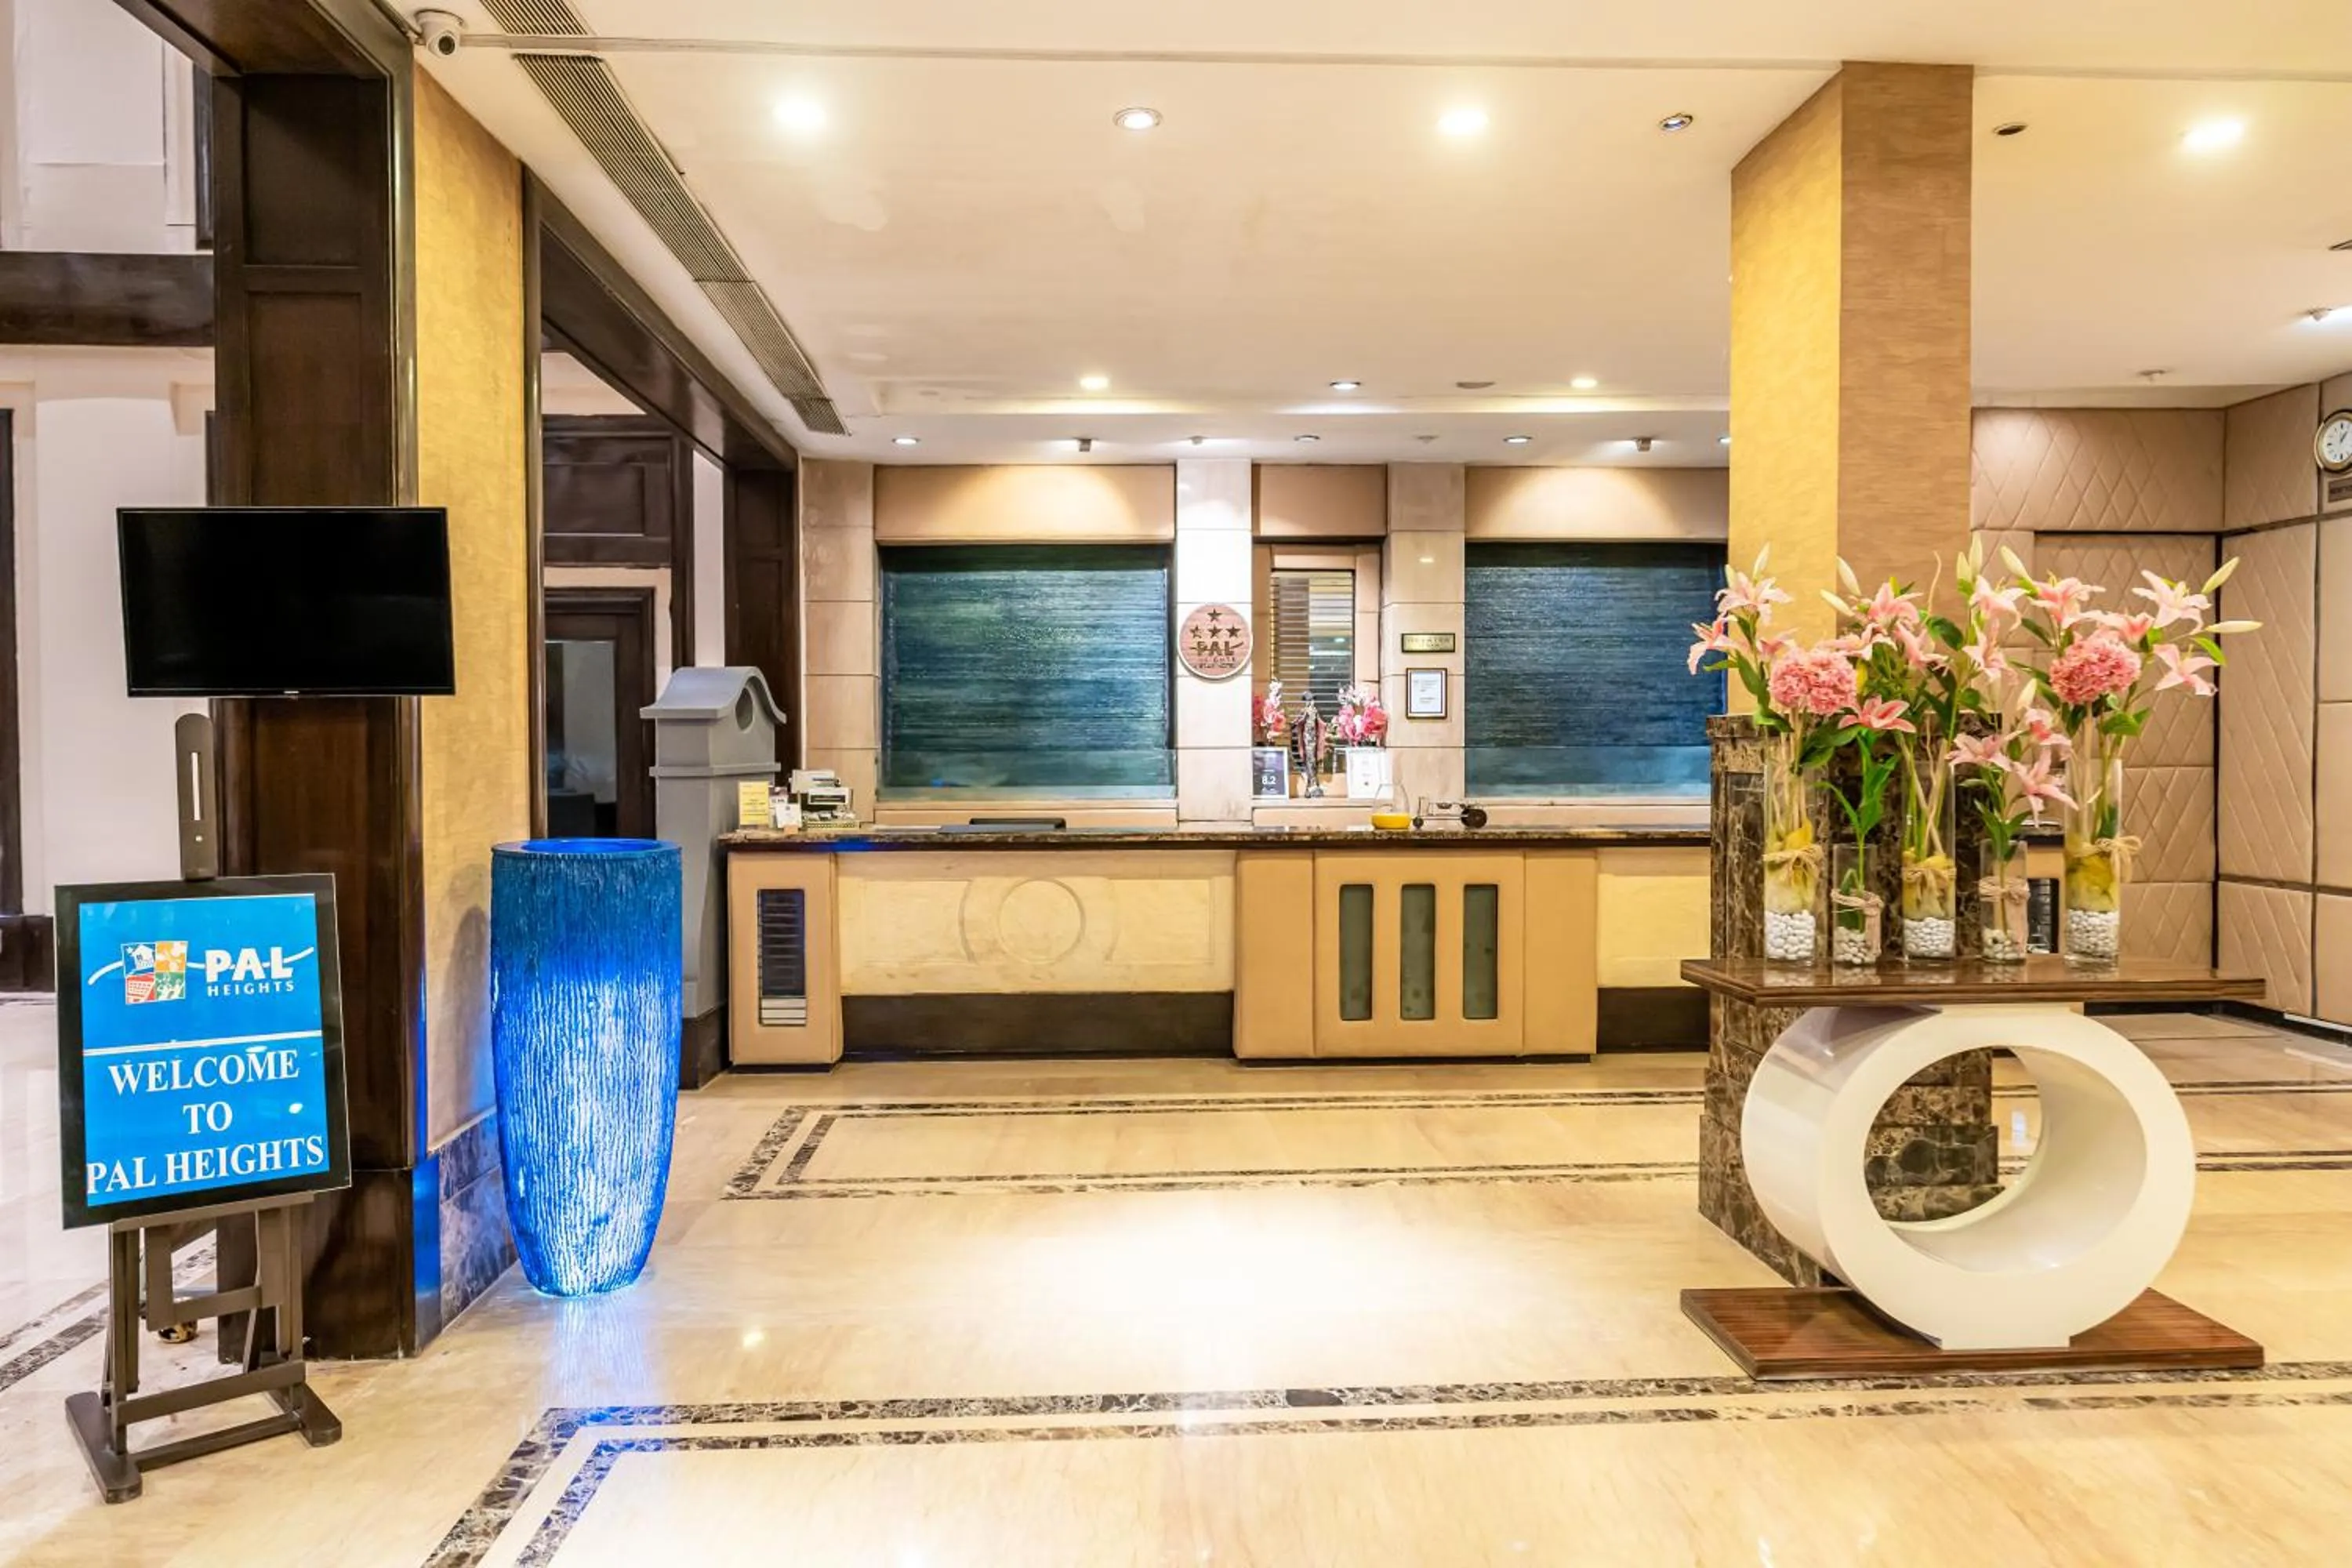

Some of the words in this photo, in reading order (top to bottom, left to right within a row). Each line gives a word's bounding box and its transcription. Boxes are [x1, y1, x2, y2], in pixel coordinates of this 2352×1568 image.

[1196, 641, 1235, 655] PAL
[205, 946, 293, 982] PAL
[208, 980, 295, 996] HEIGHTS
[109, 1051, 299, 1094] WELCOME
[183, 1101, 233, 1134] TO
[87, 1156, 156, 1194] PAL
[165, 1135, 324, 1185] HEIGHTS
